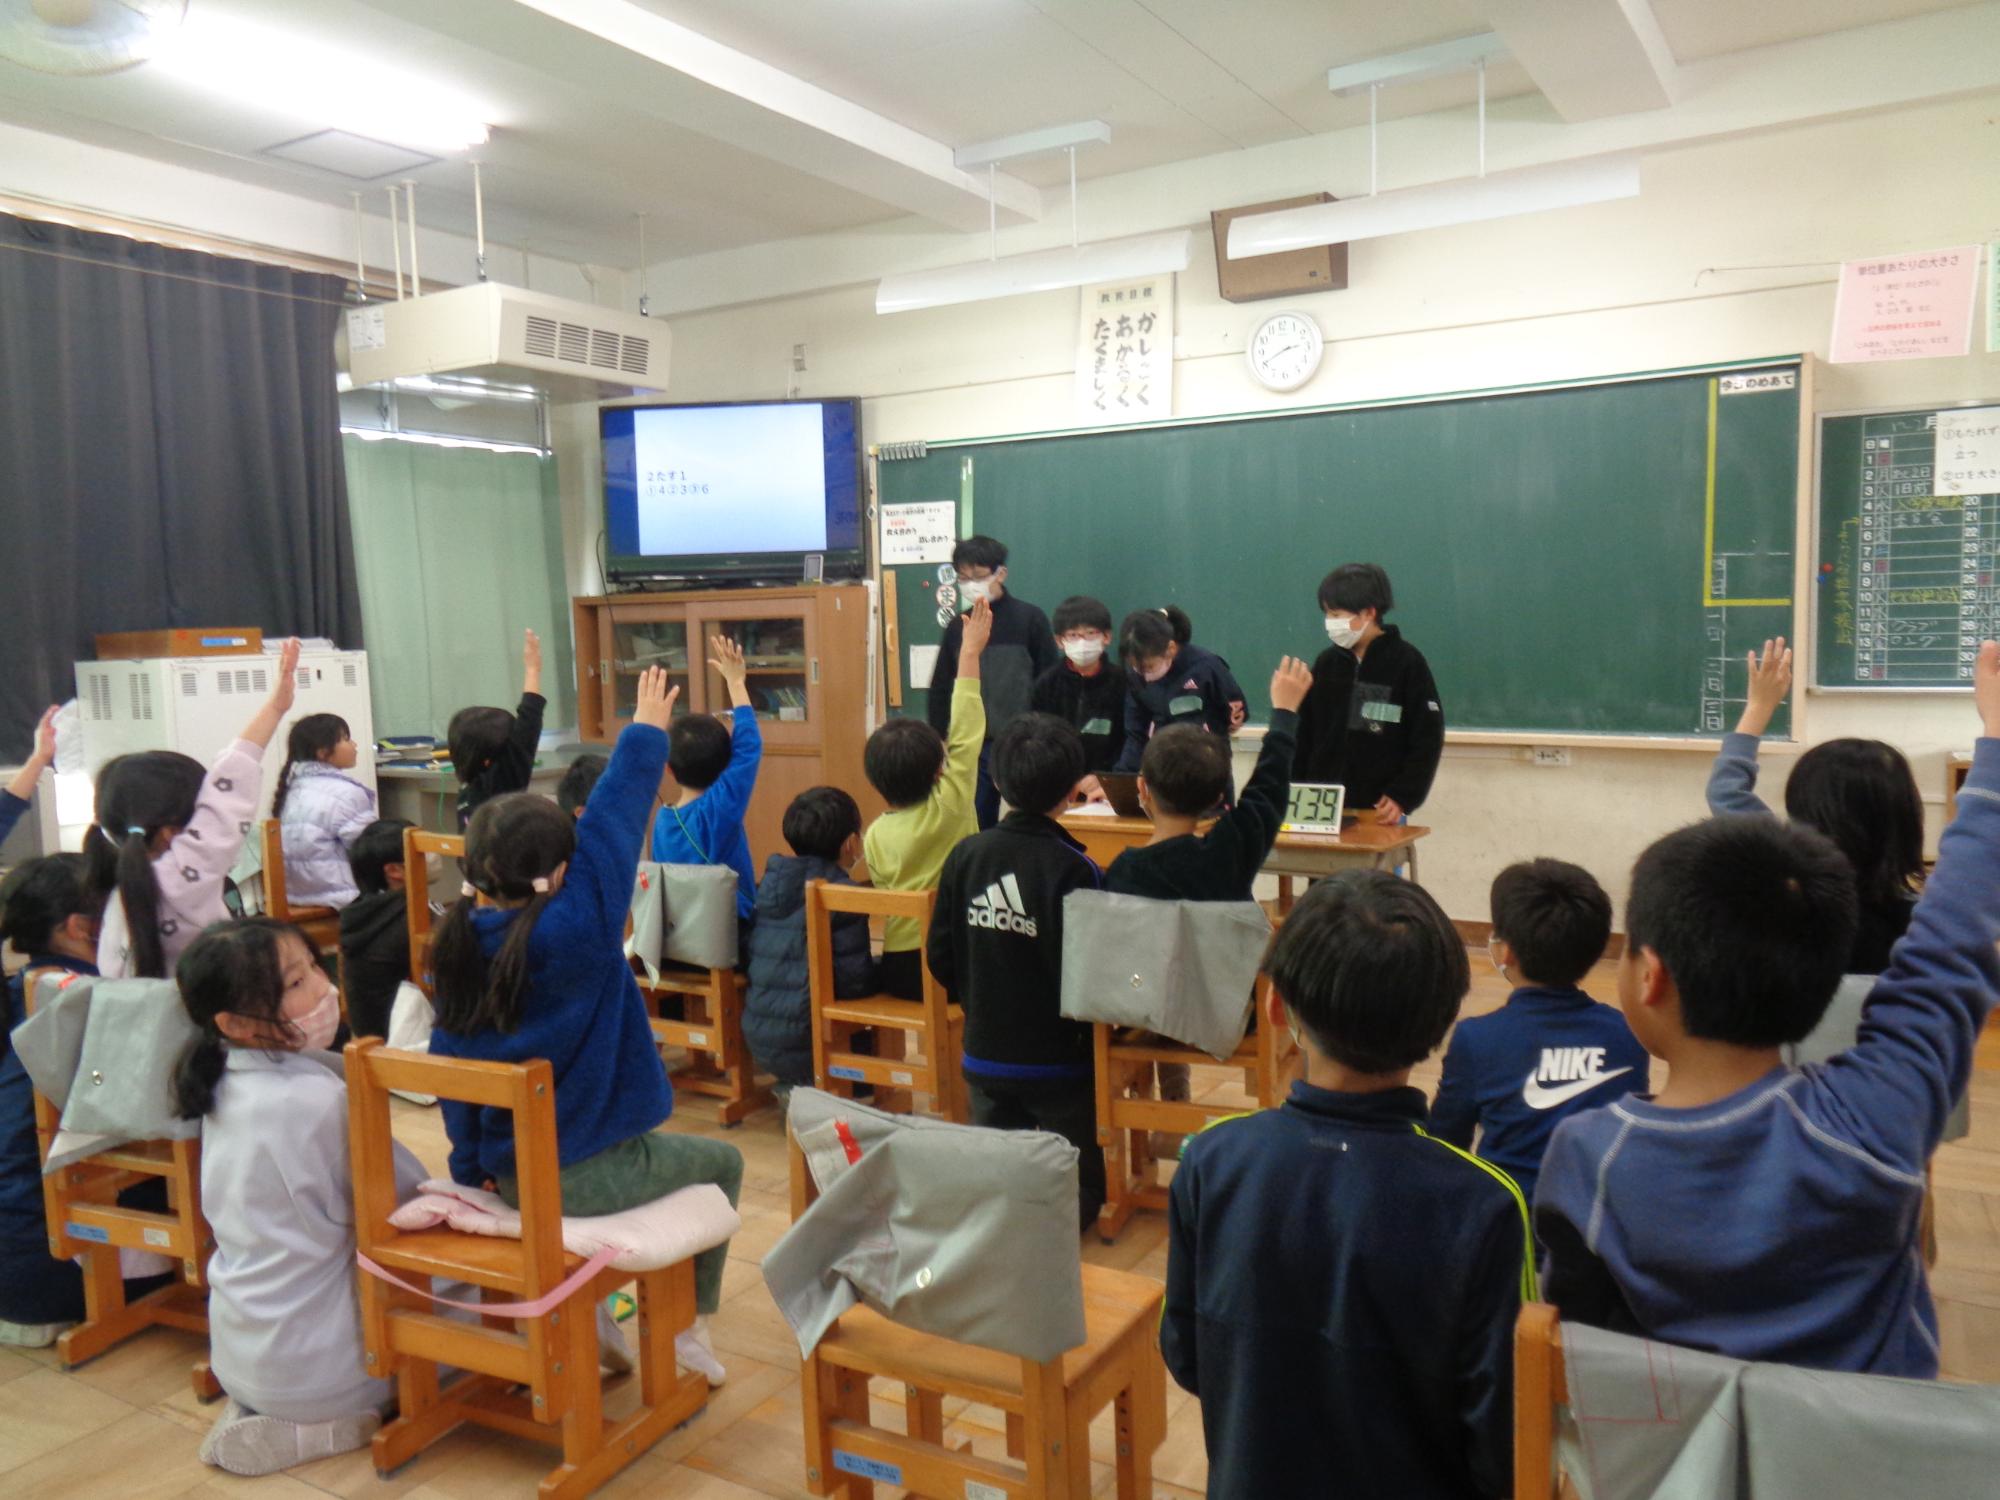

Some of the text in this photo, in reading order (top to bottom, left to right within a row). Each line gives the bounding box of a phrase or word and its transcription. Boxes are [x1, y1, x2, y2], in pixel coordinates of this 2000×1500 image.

[1866, 455, 1873, 465] 1
[1865, 470, 1874, 480] 2
[1864, 485, 1873, 496] 3
[1863, 501, 1873, 510] 4
[1964, 495, 1979, 506] 20
[1863, 516, 1873, 526] 5
[1965, 511, 1978, 521] 21
[1863, 531, 1873, 541] 6
[1964, 527, 1978, 537] 22
[1863, 546, 1872, 556] 7
[1862, 561, 1872, 572] 8
[1862, 577, 1871, 587] 9
[1860, 592, 1872, 602] 10
[1859, 608, 1871, 617] 11
[1960, 605, 1975, 615] 27
[1859, 622, 1871, 632] 12
[1859, 638, 1871, 648] 13
[1858, 652, 1871, 662] 14
[1858, 667, 1871, 677] 15
[1960, 667, 1973, 677] 31
[968, 906, 1037, 937] adidas
[1538, 1047, 1606, 1081] NIKE
